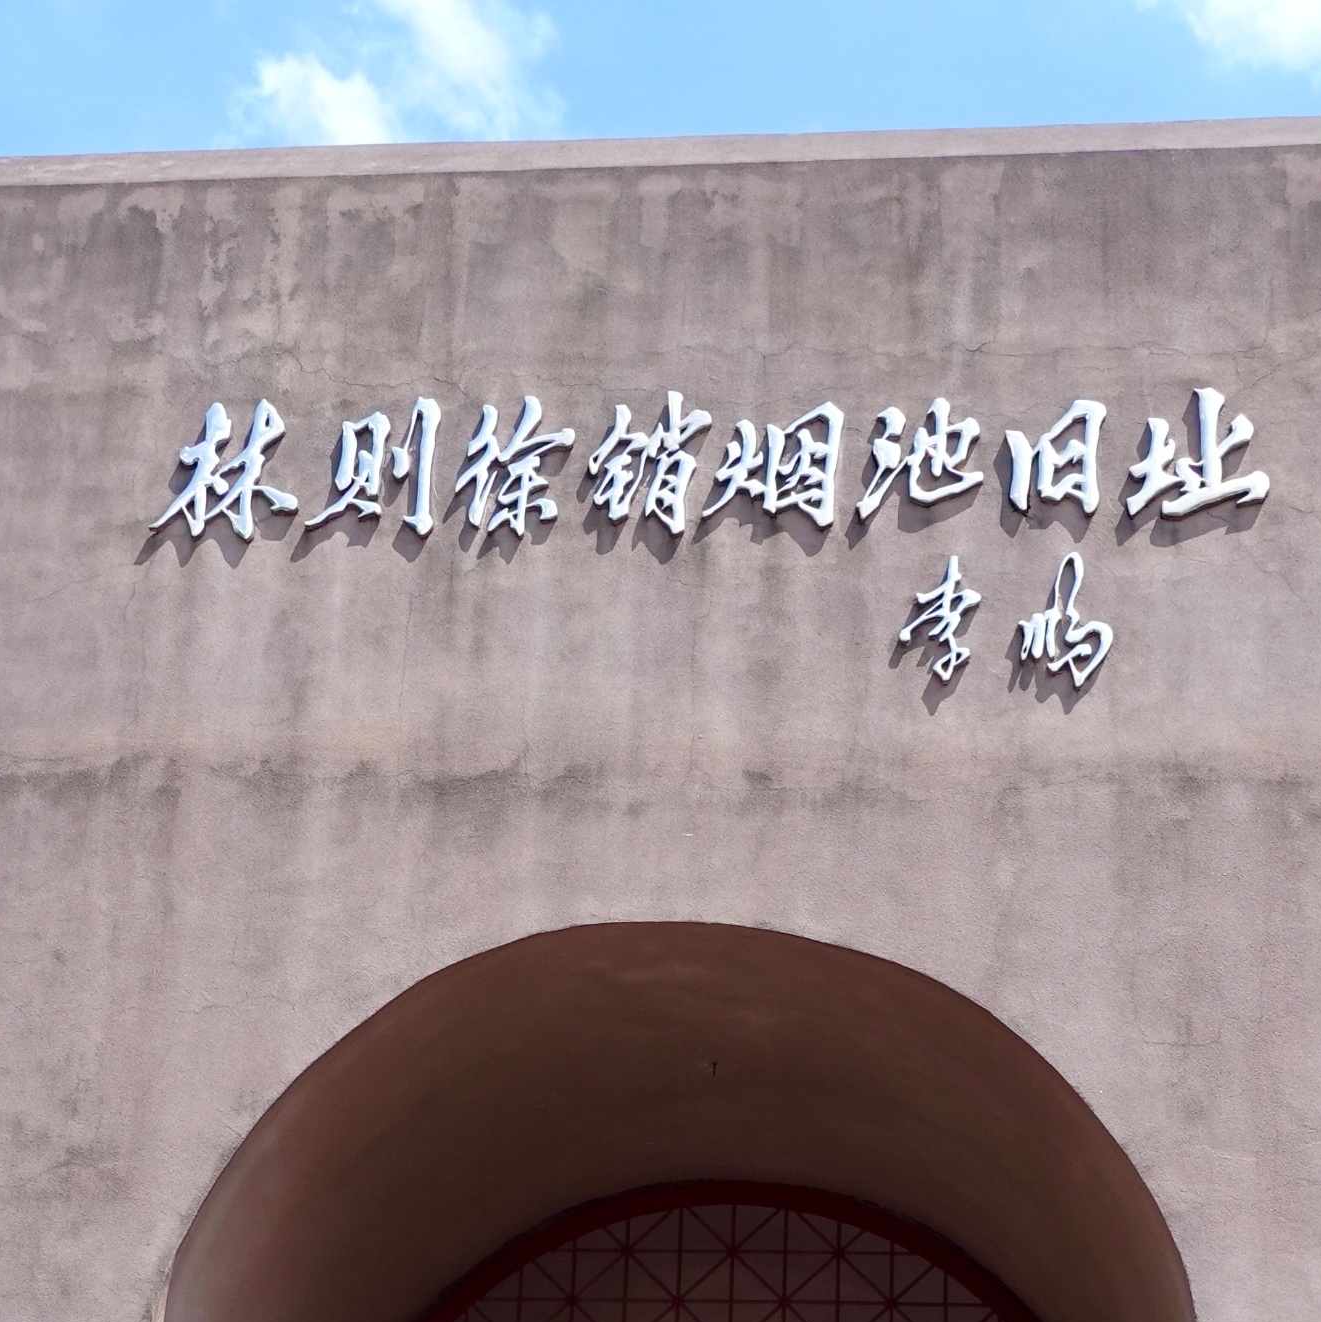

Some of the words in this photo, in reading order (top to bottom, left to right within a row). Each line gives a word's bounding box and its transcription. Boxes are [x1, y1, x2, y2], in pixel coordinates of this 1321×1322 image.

[150, 386, 1271, 540] 林则徐销烟池旧址
